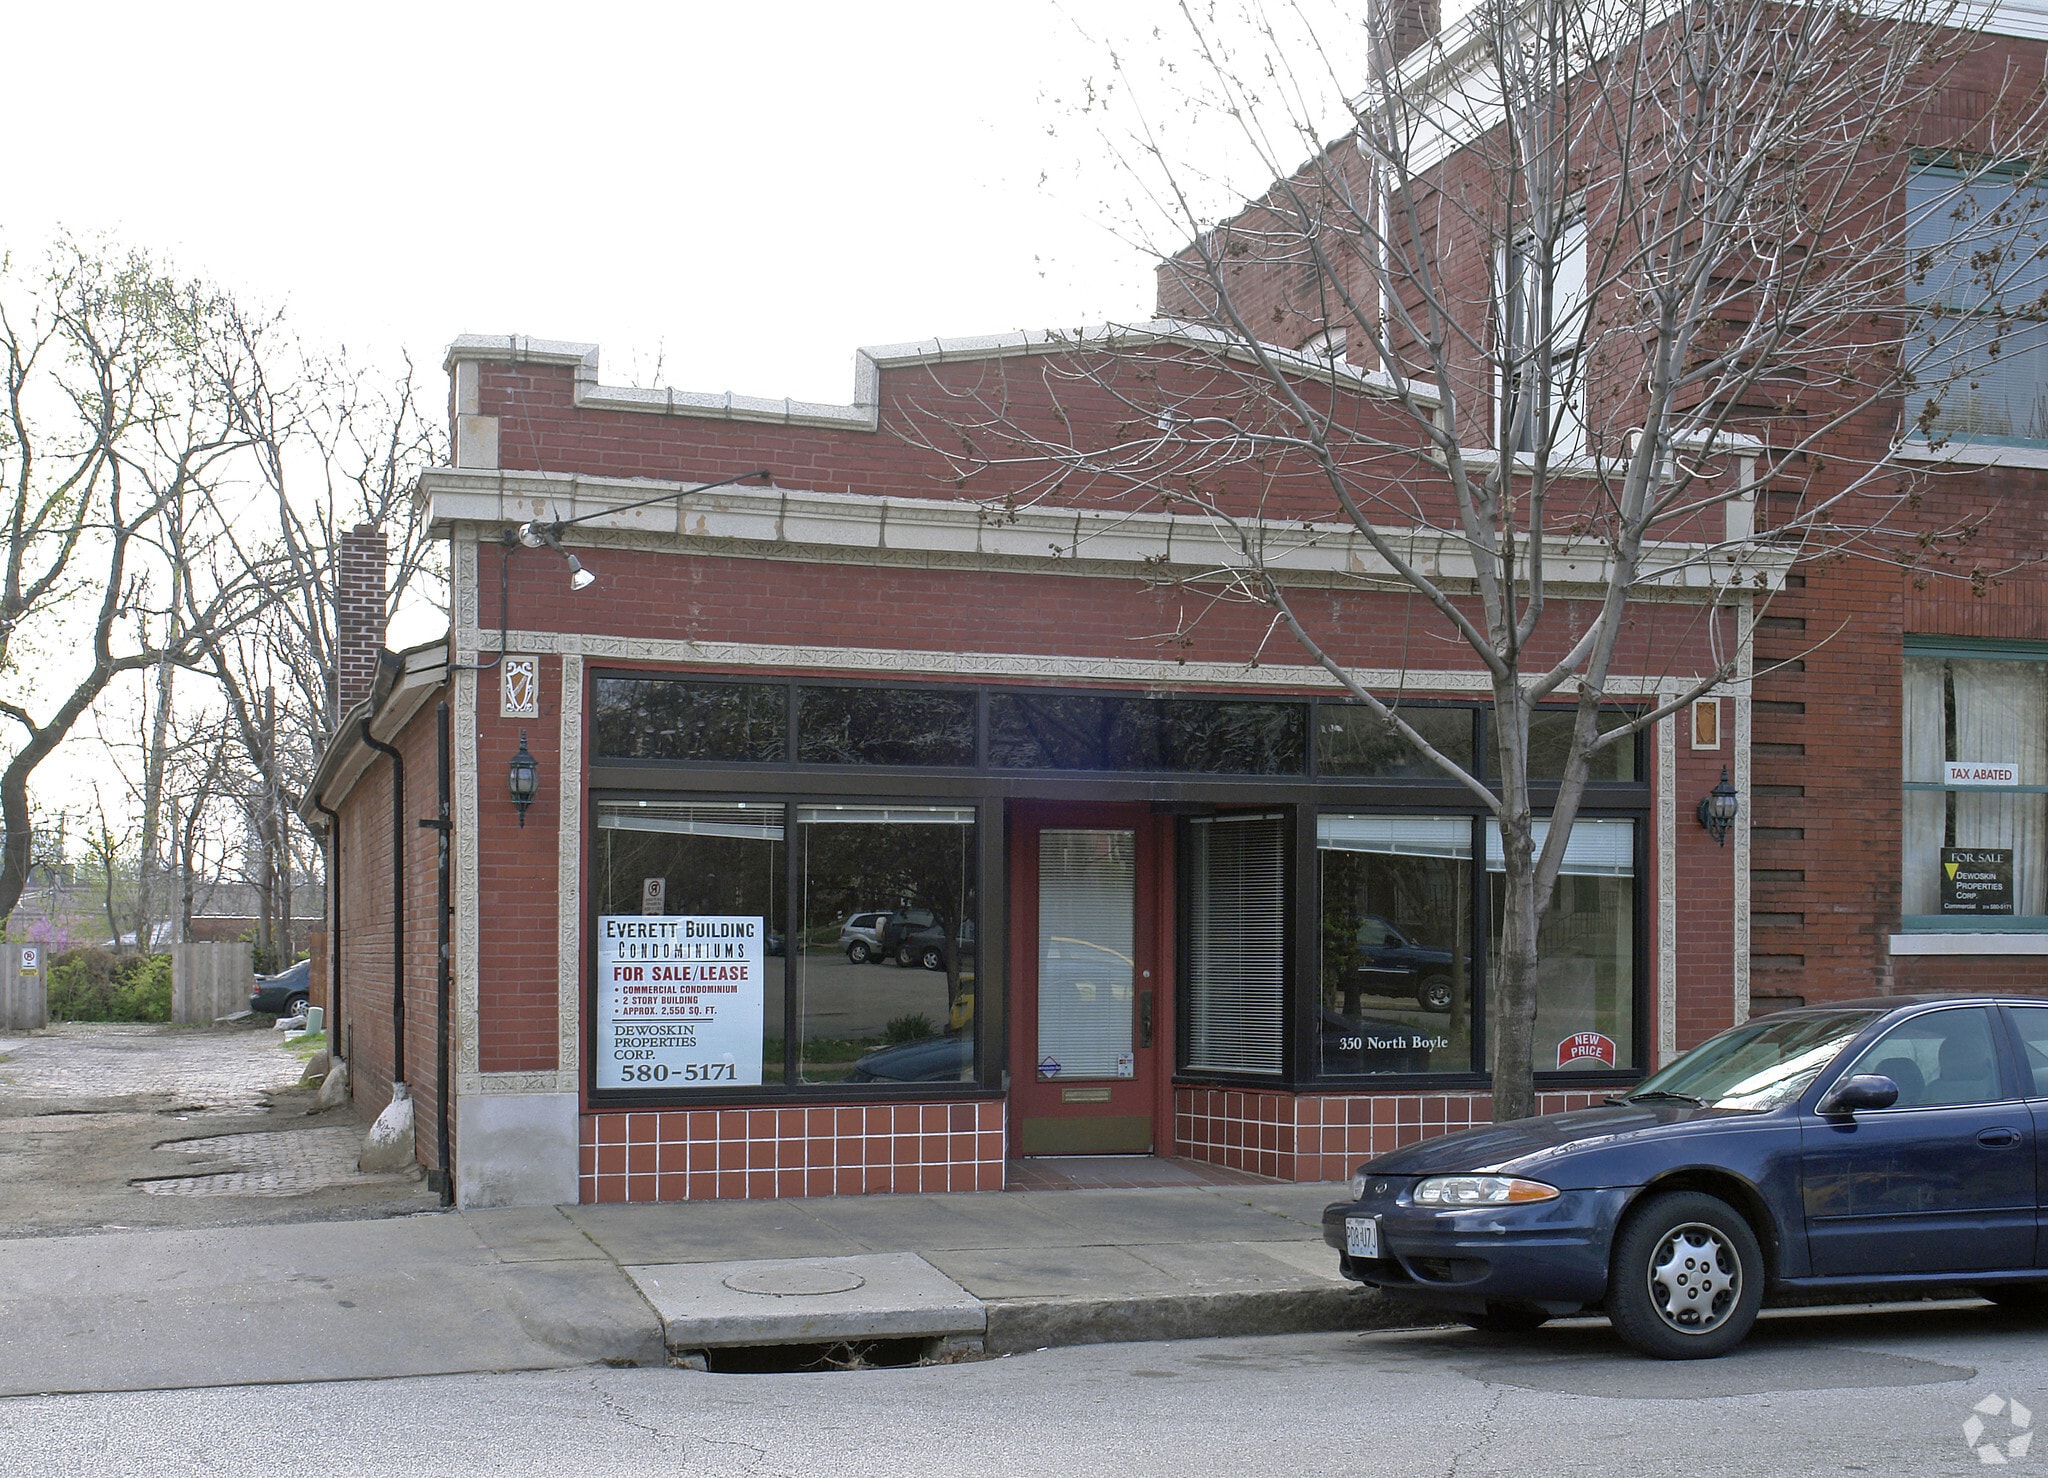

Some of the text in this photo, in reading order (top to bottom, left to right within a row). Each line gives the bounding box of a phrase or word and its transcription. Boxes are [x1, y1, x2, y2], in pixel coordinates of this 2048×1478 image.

[1951, 768, 2013, 781] TAX ABATED
[1951, 853, 2004, 863] FOR SALE
[607, 920, 677, 938] EVERETT
[613, 965, 749, 981] FOR SALE/LEASE
[623, 985, 738, 994] COMMERCIAL CONDOMINIUM
[623, 996, 699, 1005] 2 STORY BUILDING
[623, 1006, 717, 1016] APPROX. 2,550 SQ. FT.
[614, 1025, 695, 1036] DEWOSKIN
[614, 1037, 697, 1048] PROPERTIES
[1339, 1036, 1449, 1053] 350 North Boyle
[1574, 1034, 1600, 1046] NEW
[614, 1049, 656, 1060] CORP.
[1570, 1045, 1603, 1058] PRICE
[620, 1063, 738, 1082] 580-5171
